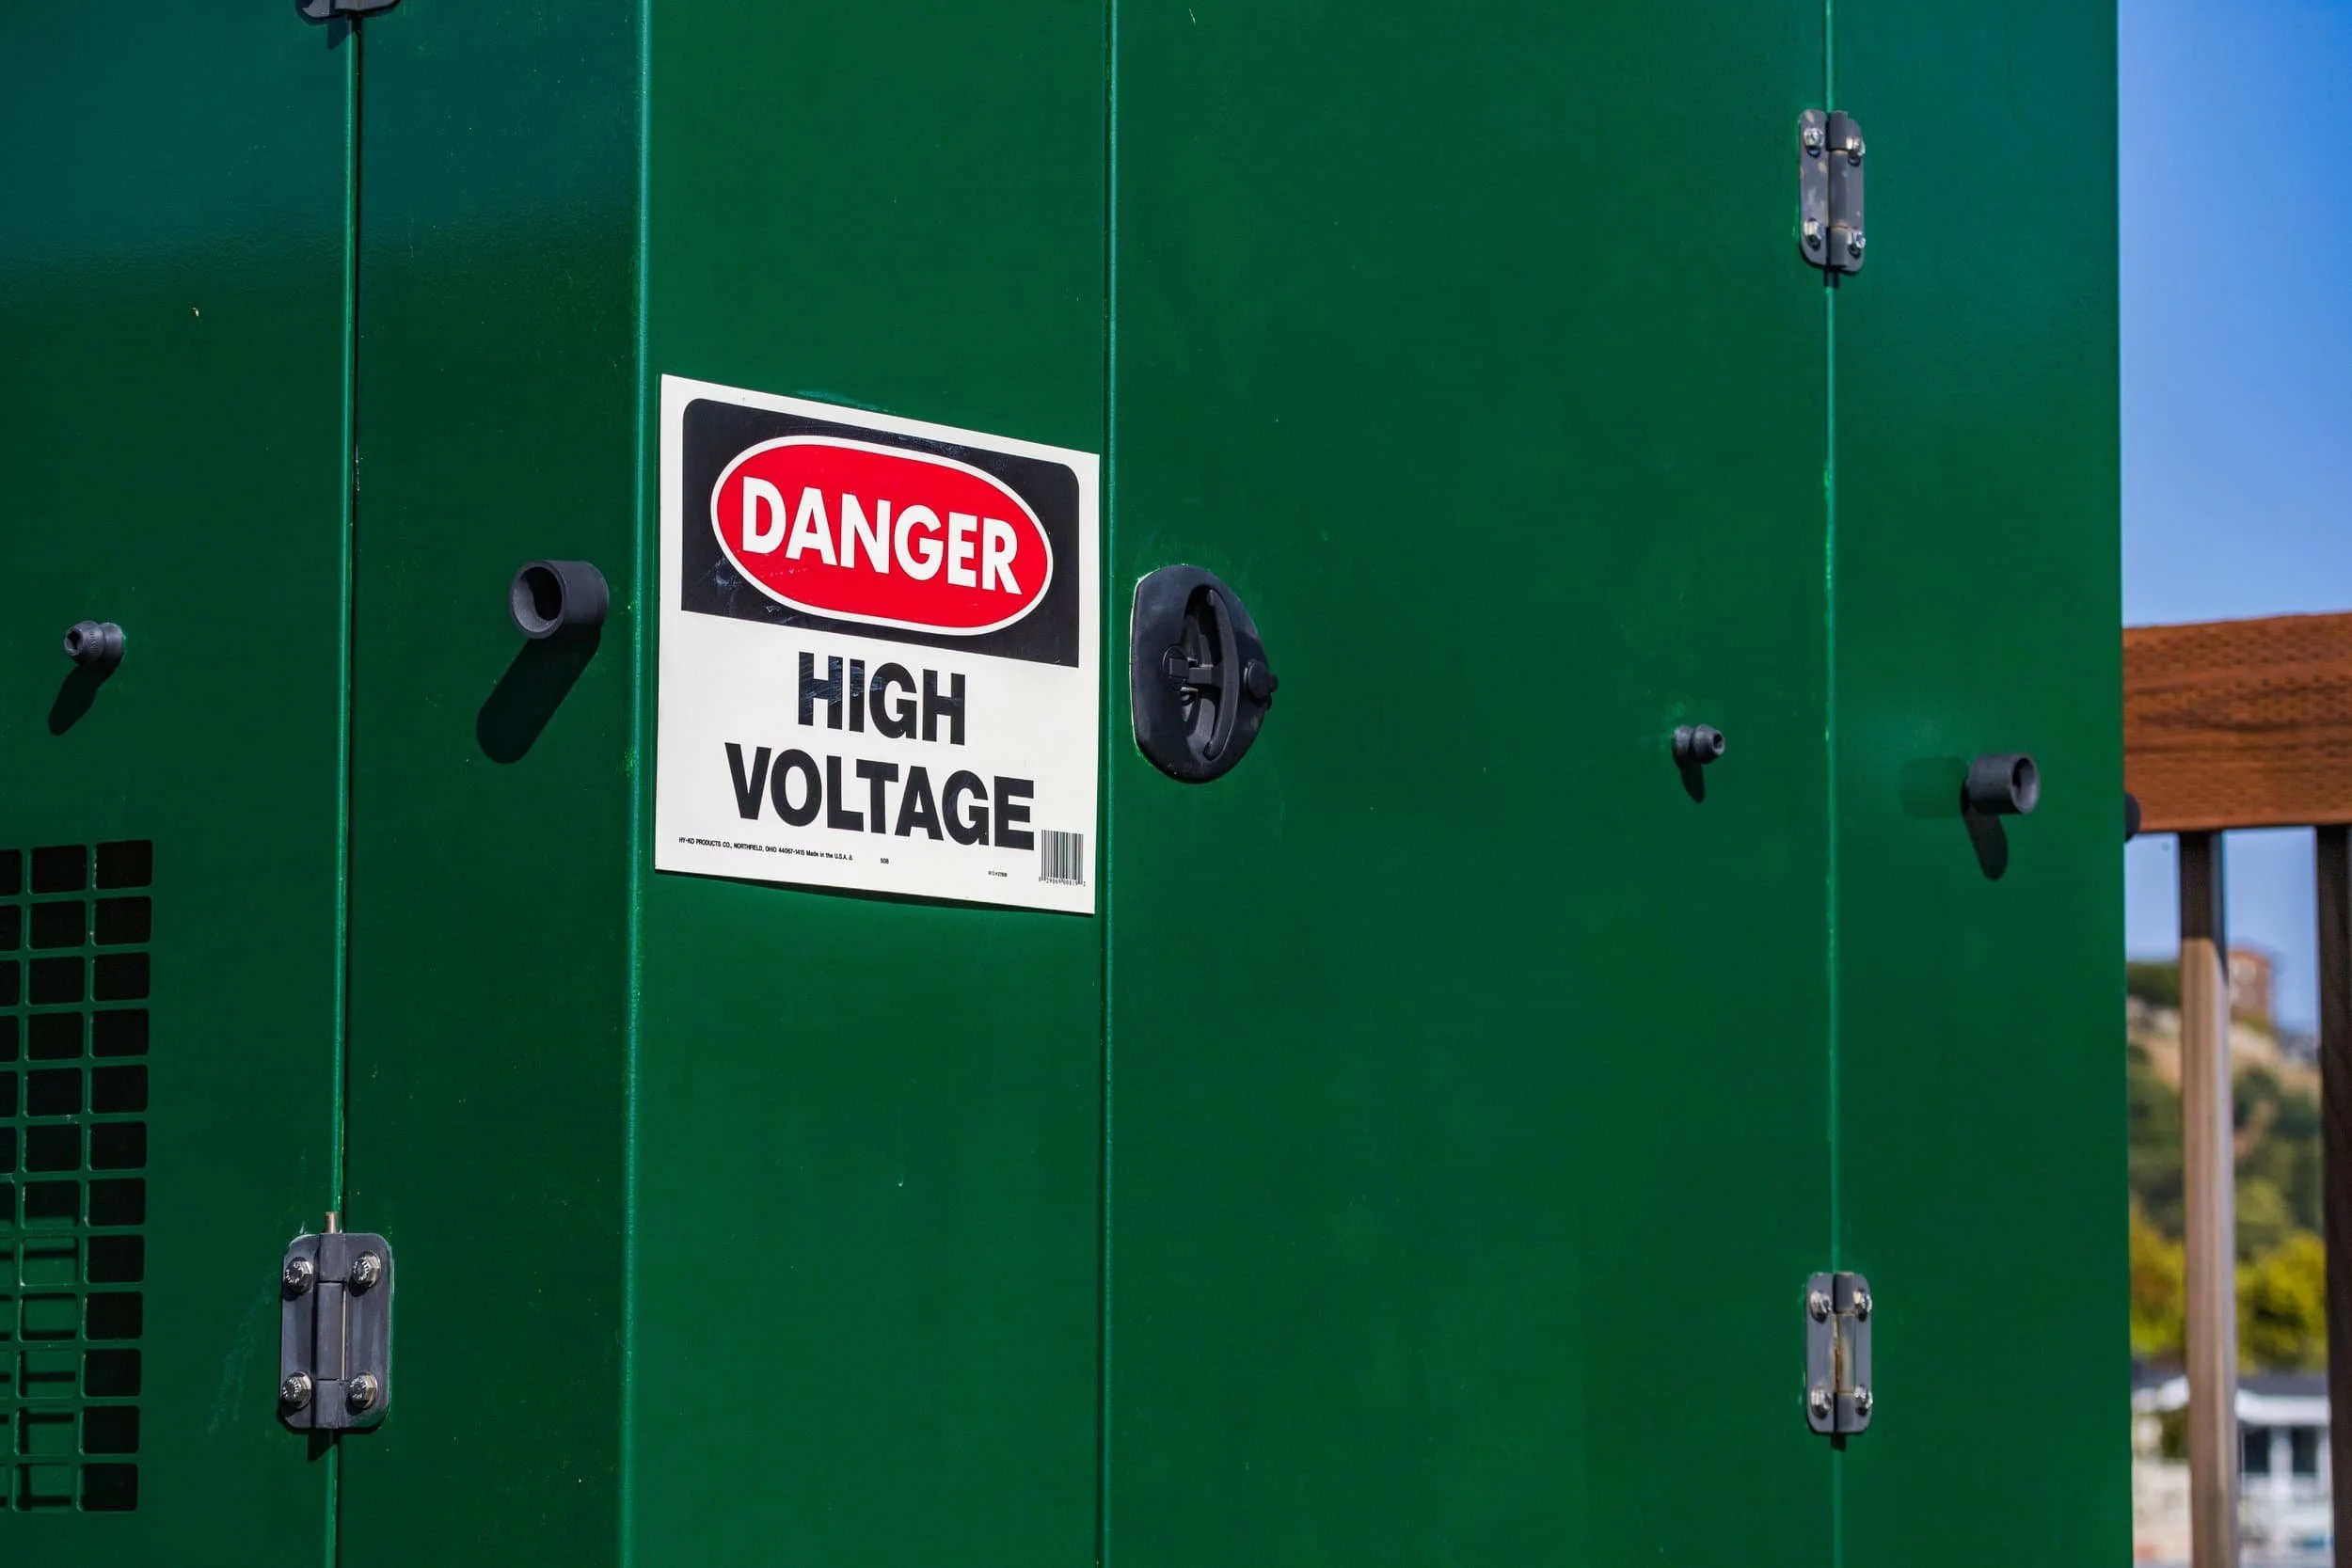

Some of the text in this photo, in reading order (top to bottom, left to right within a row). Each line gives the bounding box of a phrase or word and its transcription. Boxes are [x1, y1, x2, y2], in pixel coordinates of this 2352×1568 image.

[742, 476, 1022, 595] DANGER
[798, 651, 966, 746] HIGH
[678, 836, 695, 845] HY-KO
[695, 838, 722, 847] PRODUCTS
[733, 842, 765, 852] NORTHFIELD,
[765, 845, 777, 853] OHIO
[724, 742, 1035, 851] VOLTAGE
